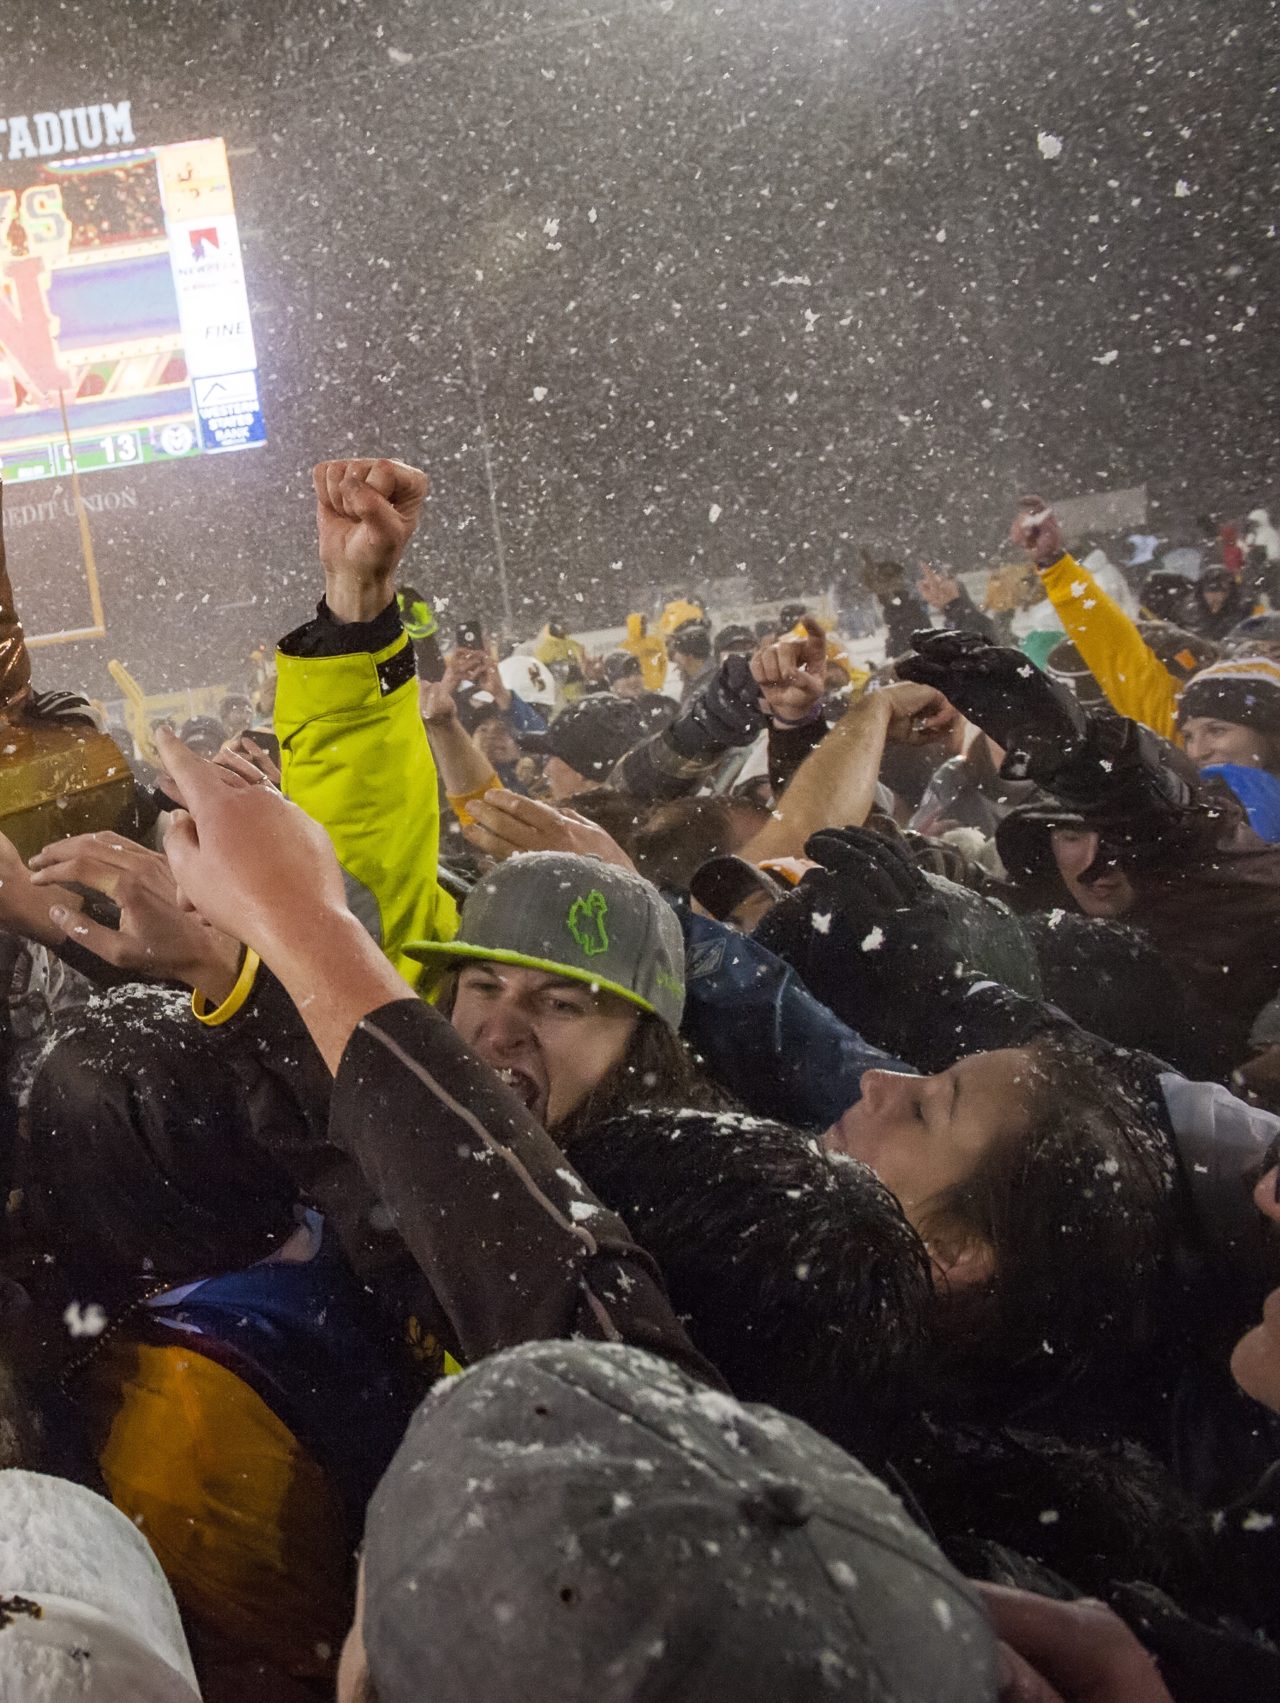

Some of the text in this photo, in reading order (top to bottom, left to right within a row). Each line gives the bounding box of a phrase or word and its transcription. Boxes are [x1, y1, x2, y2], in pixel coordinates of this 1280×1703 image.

[205, 320, 247, 340] FINE
[100, 433, 137, 464] 13
[63, 488, 138, 516] UNION
